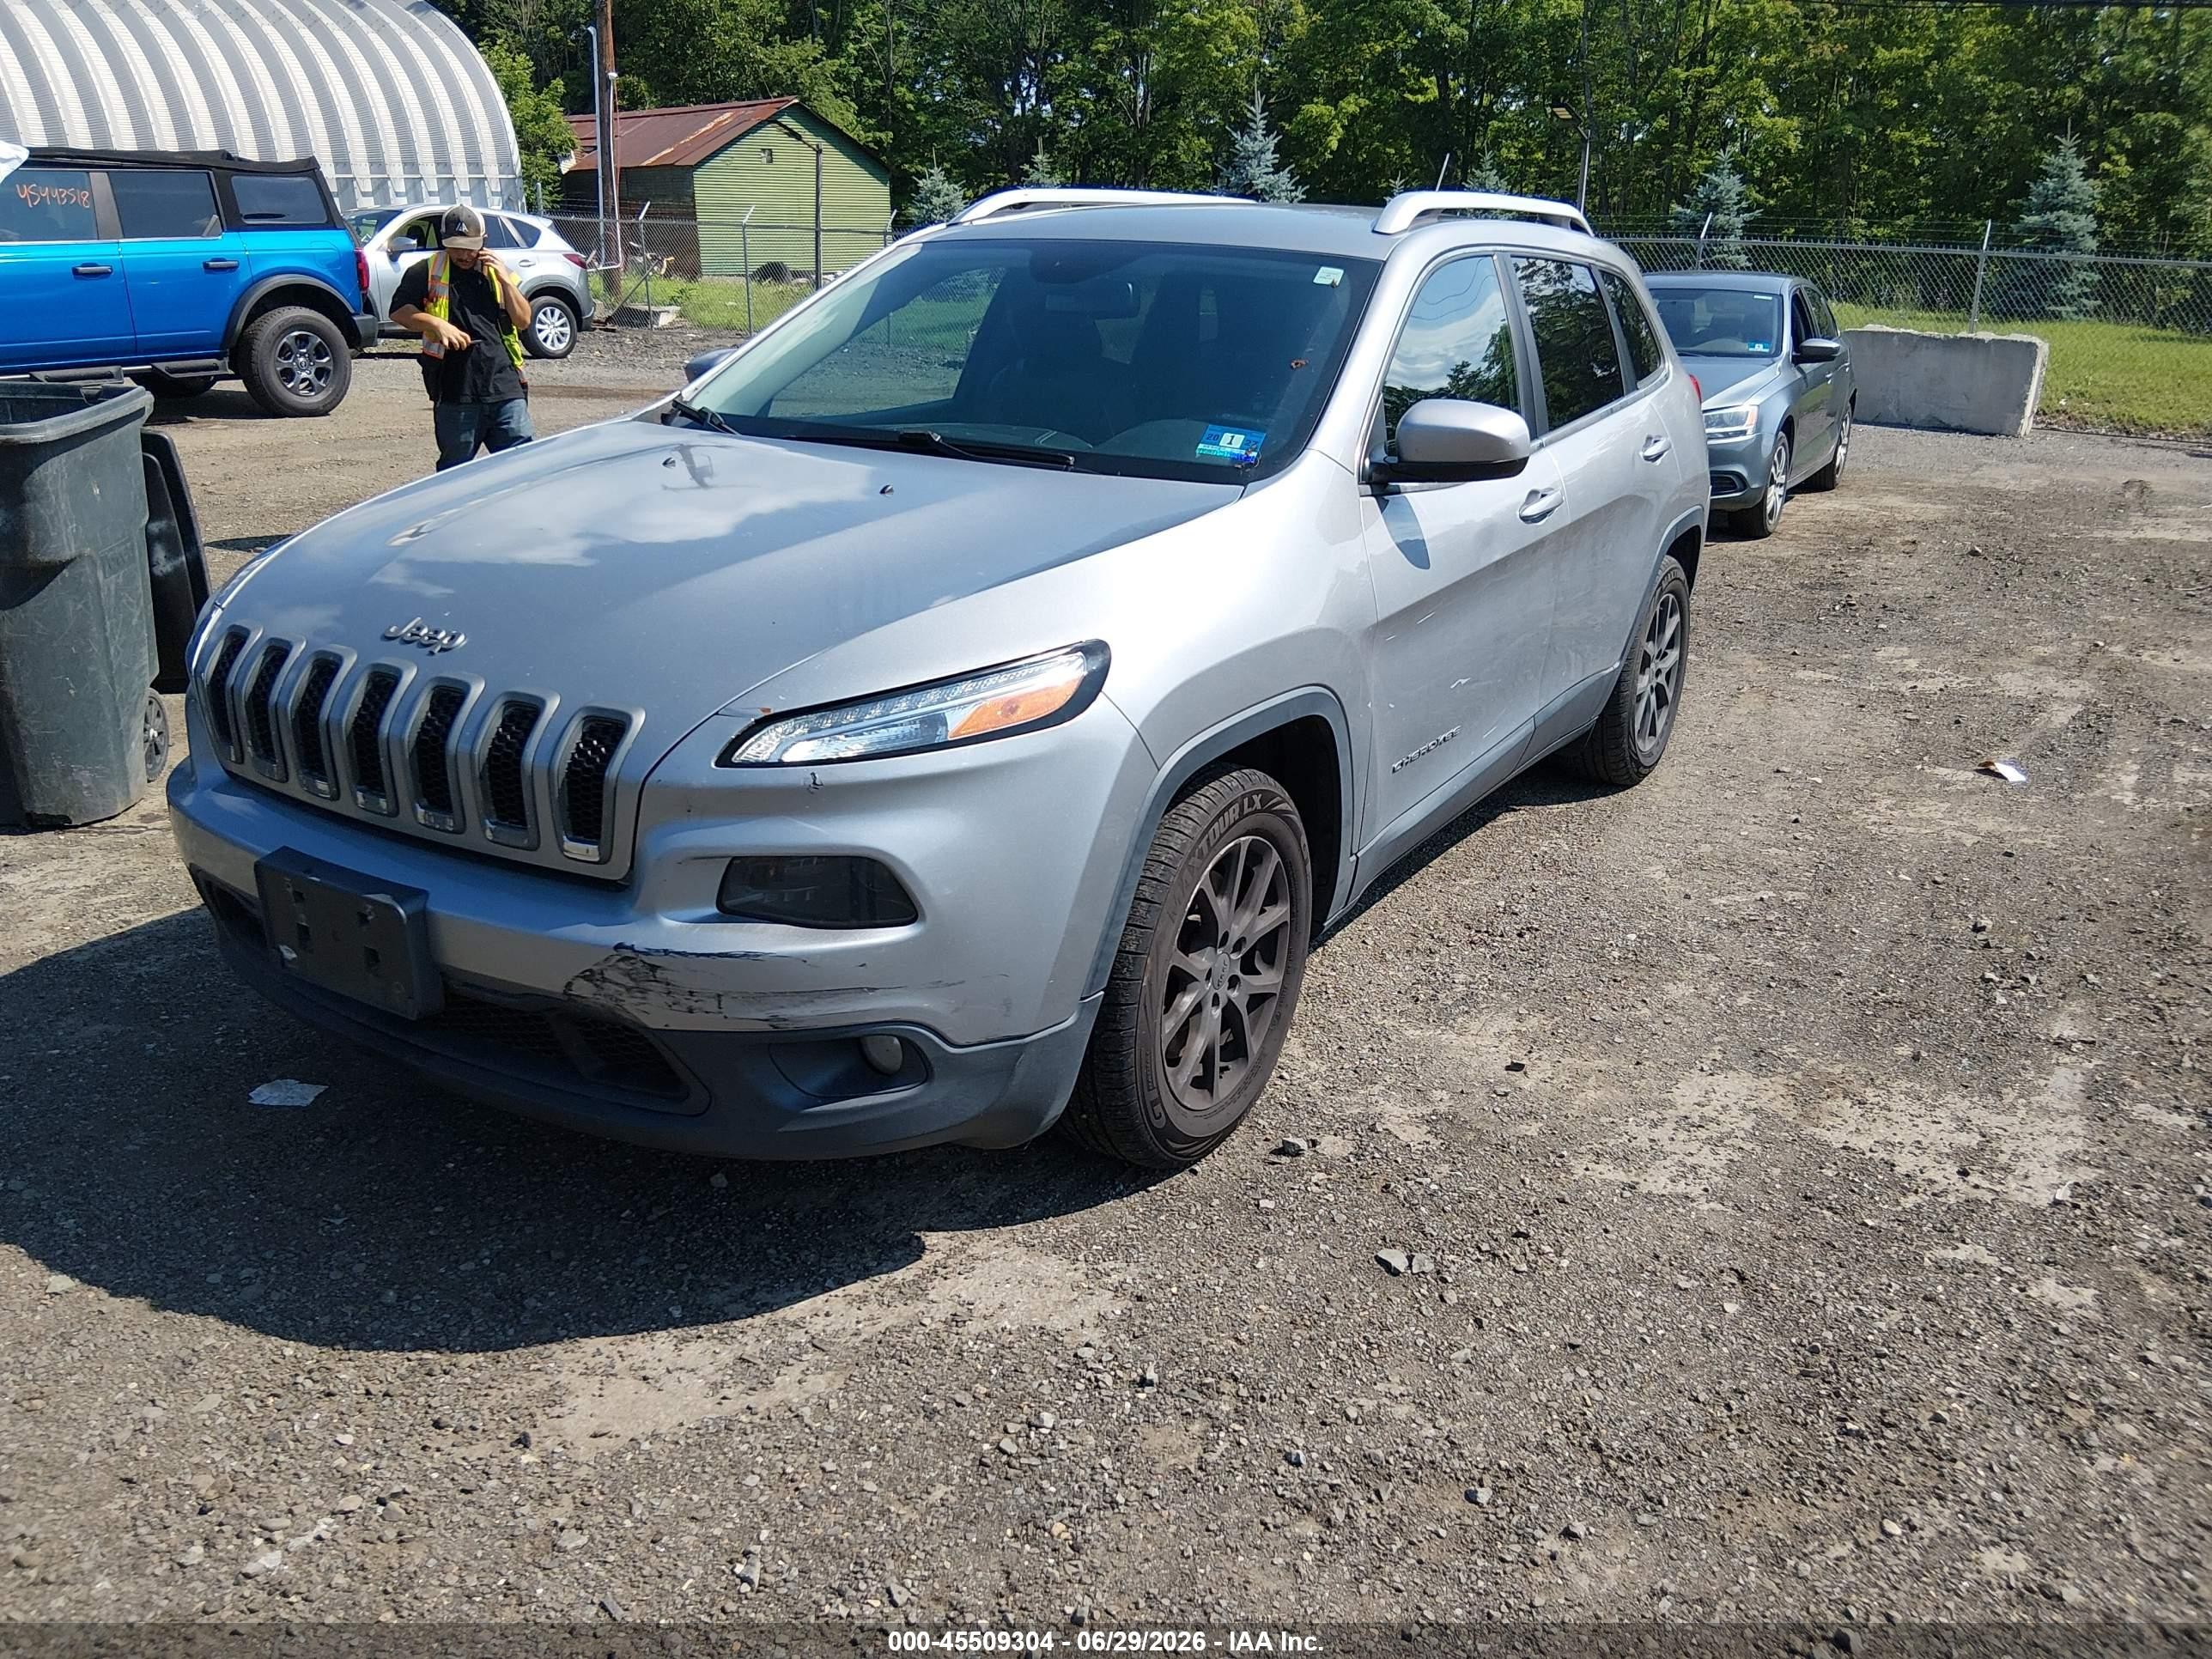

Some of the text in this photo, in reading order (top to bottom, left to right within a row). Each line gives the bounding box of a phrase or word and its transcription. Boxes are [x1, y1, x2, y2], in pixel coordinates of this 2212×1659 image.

[15, 183, 90, 208] 45443518
[1206, 433, 1219, 441] 20
[1226, 434, 1235, 446] 1
[384, 617, 466, 653] Jeep
[1392, 725, 1462, 774] CHEROKEE
[1243, 793, 1262, 815] LX
